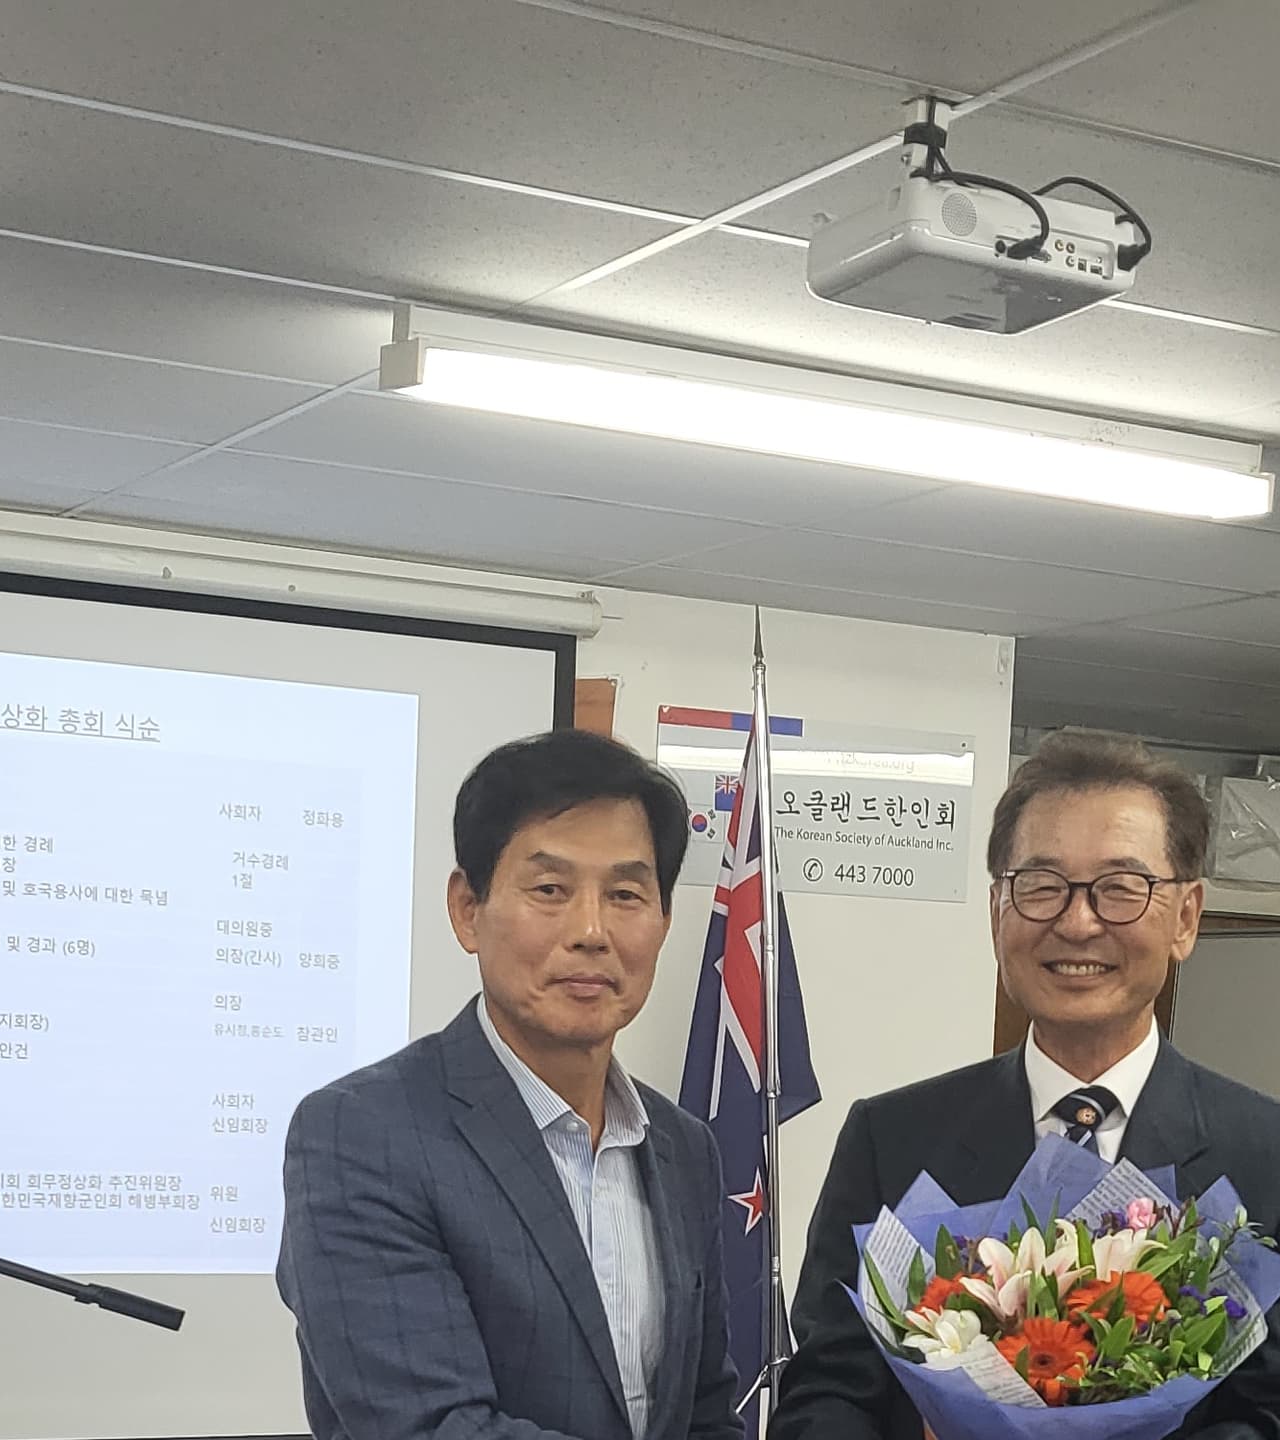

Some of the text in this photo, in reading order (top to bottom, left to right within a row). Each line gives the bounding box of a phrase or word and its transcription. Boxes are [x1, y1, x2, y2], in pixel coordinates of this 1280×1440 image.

[58, 707, 104, 735] 총회
[115, 713, 161, 742] 식순
[218, 802, 262, 823] 사회자
[775, 789, 956, 831] 오클랜드한인회
[23, 834, 54, 854] 경례
[774, 826, 954, 851] The Korean Society of Auckland Inc.
[232, 851, 289, 871] 거수경례
[232, 873, 253, 889] 1절
[834, 863, 915, 886] 443 7000
[2, 880, 16, 897] 및
[22, 881, 99, 902] 호국용사에
[104, 887, 134, 905] 대한
[139, 889, 169, 907] 묵념
[7, 936, 21, 953] 및
[26, 936, 56, 954] 경과
[62, 939, 96, 957] (6명)
[215, 947, 282, 968] 의장(간사)
[214, 994, 243, 1012] 의장
[296, 1026, 339, 1044] 참관인
[211, 1092, 255, 1110] 사회자
[211, 1116, 269, 1135] 신임회장
[27, 1174, 103, 1191] 회무정상화
[108, 1175, 184, 1192] 추진위원장
[209, 1185, 240, 1203] 위원
[209, 1217, 266, 1234] 신임회장
